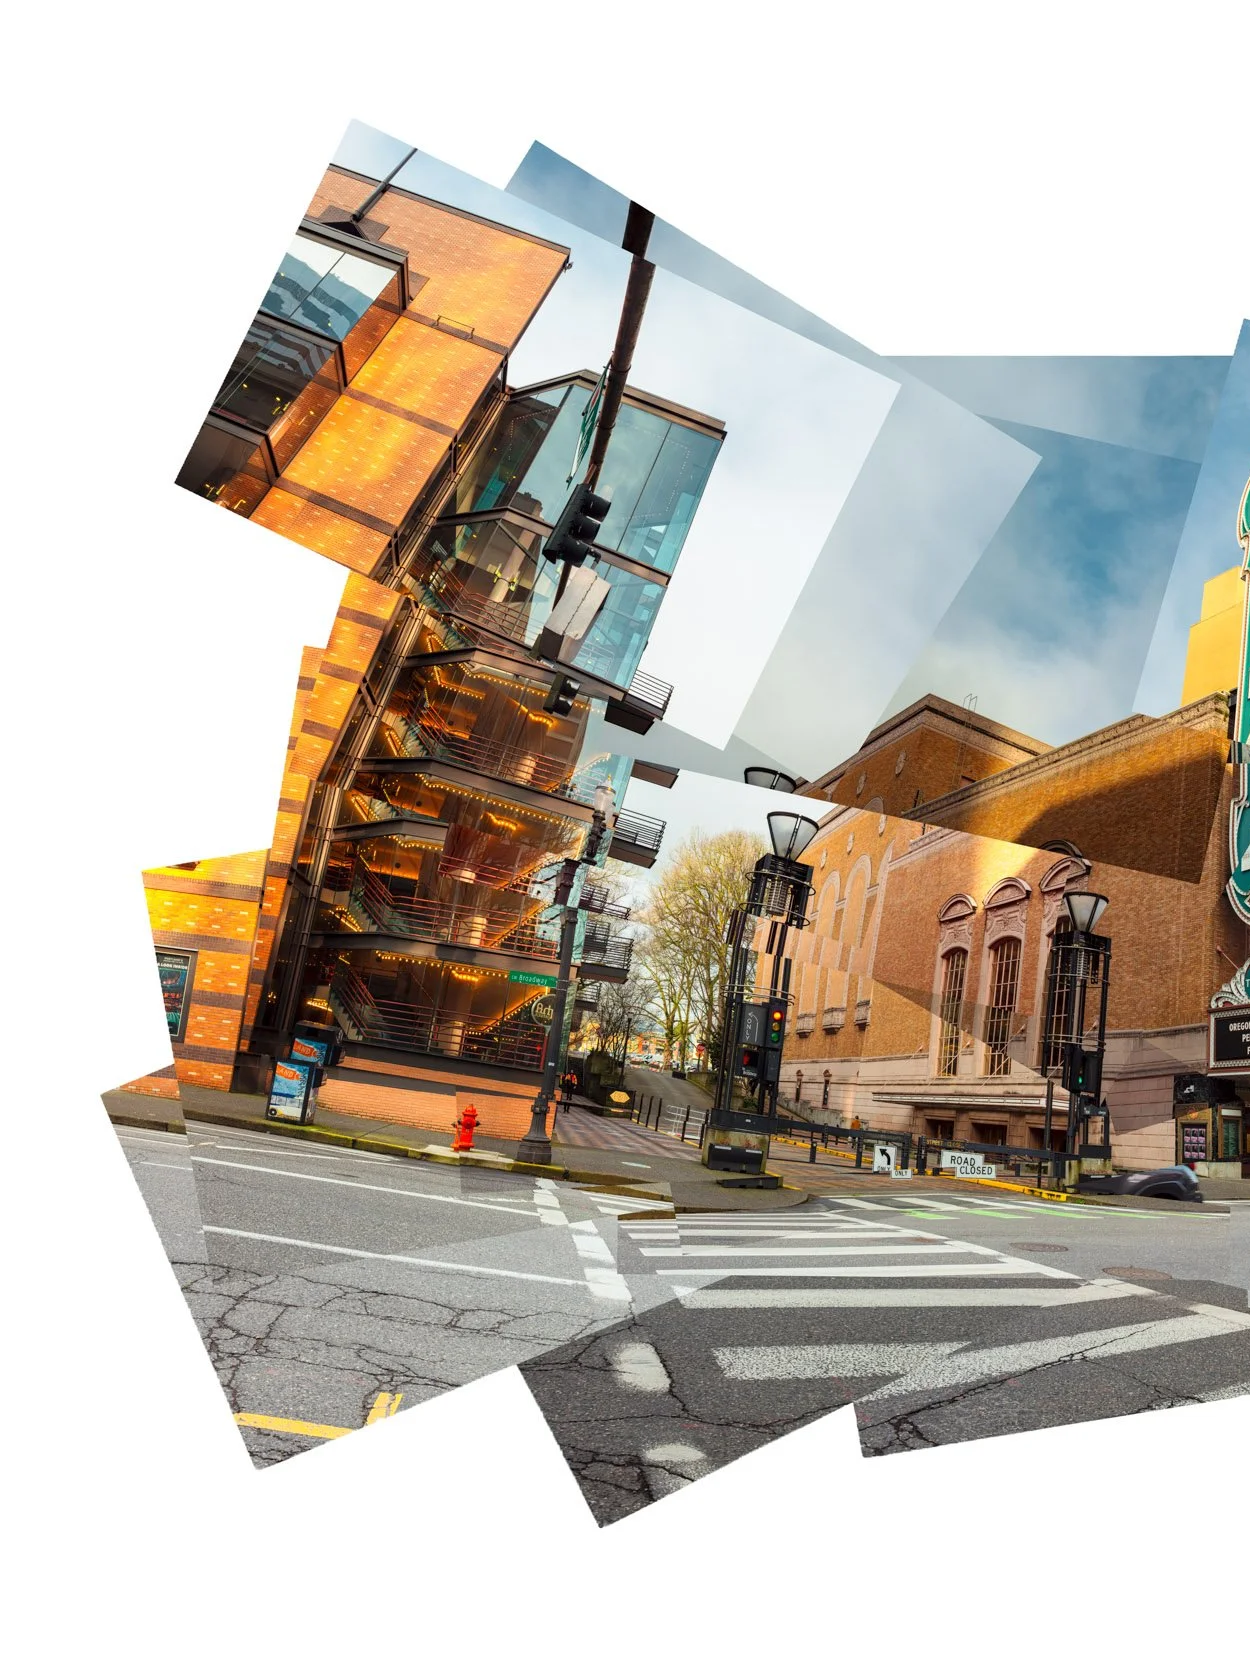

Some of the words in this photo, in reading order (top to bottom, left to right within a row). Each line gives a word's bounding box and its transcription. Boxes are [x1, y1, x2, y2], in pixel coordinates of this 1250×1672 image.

[519, 974, 548, 986] Broadway
[744, 1018, 753, 1041] ONLY
[950, 1156, 976, 1167] ROAD
[959, 1166, 993, 1176] CLOSED
